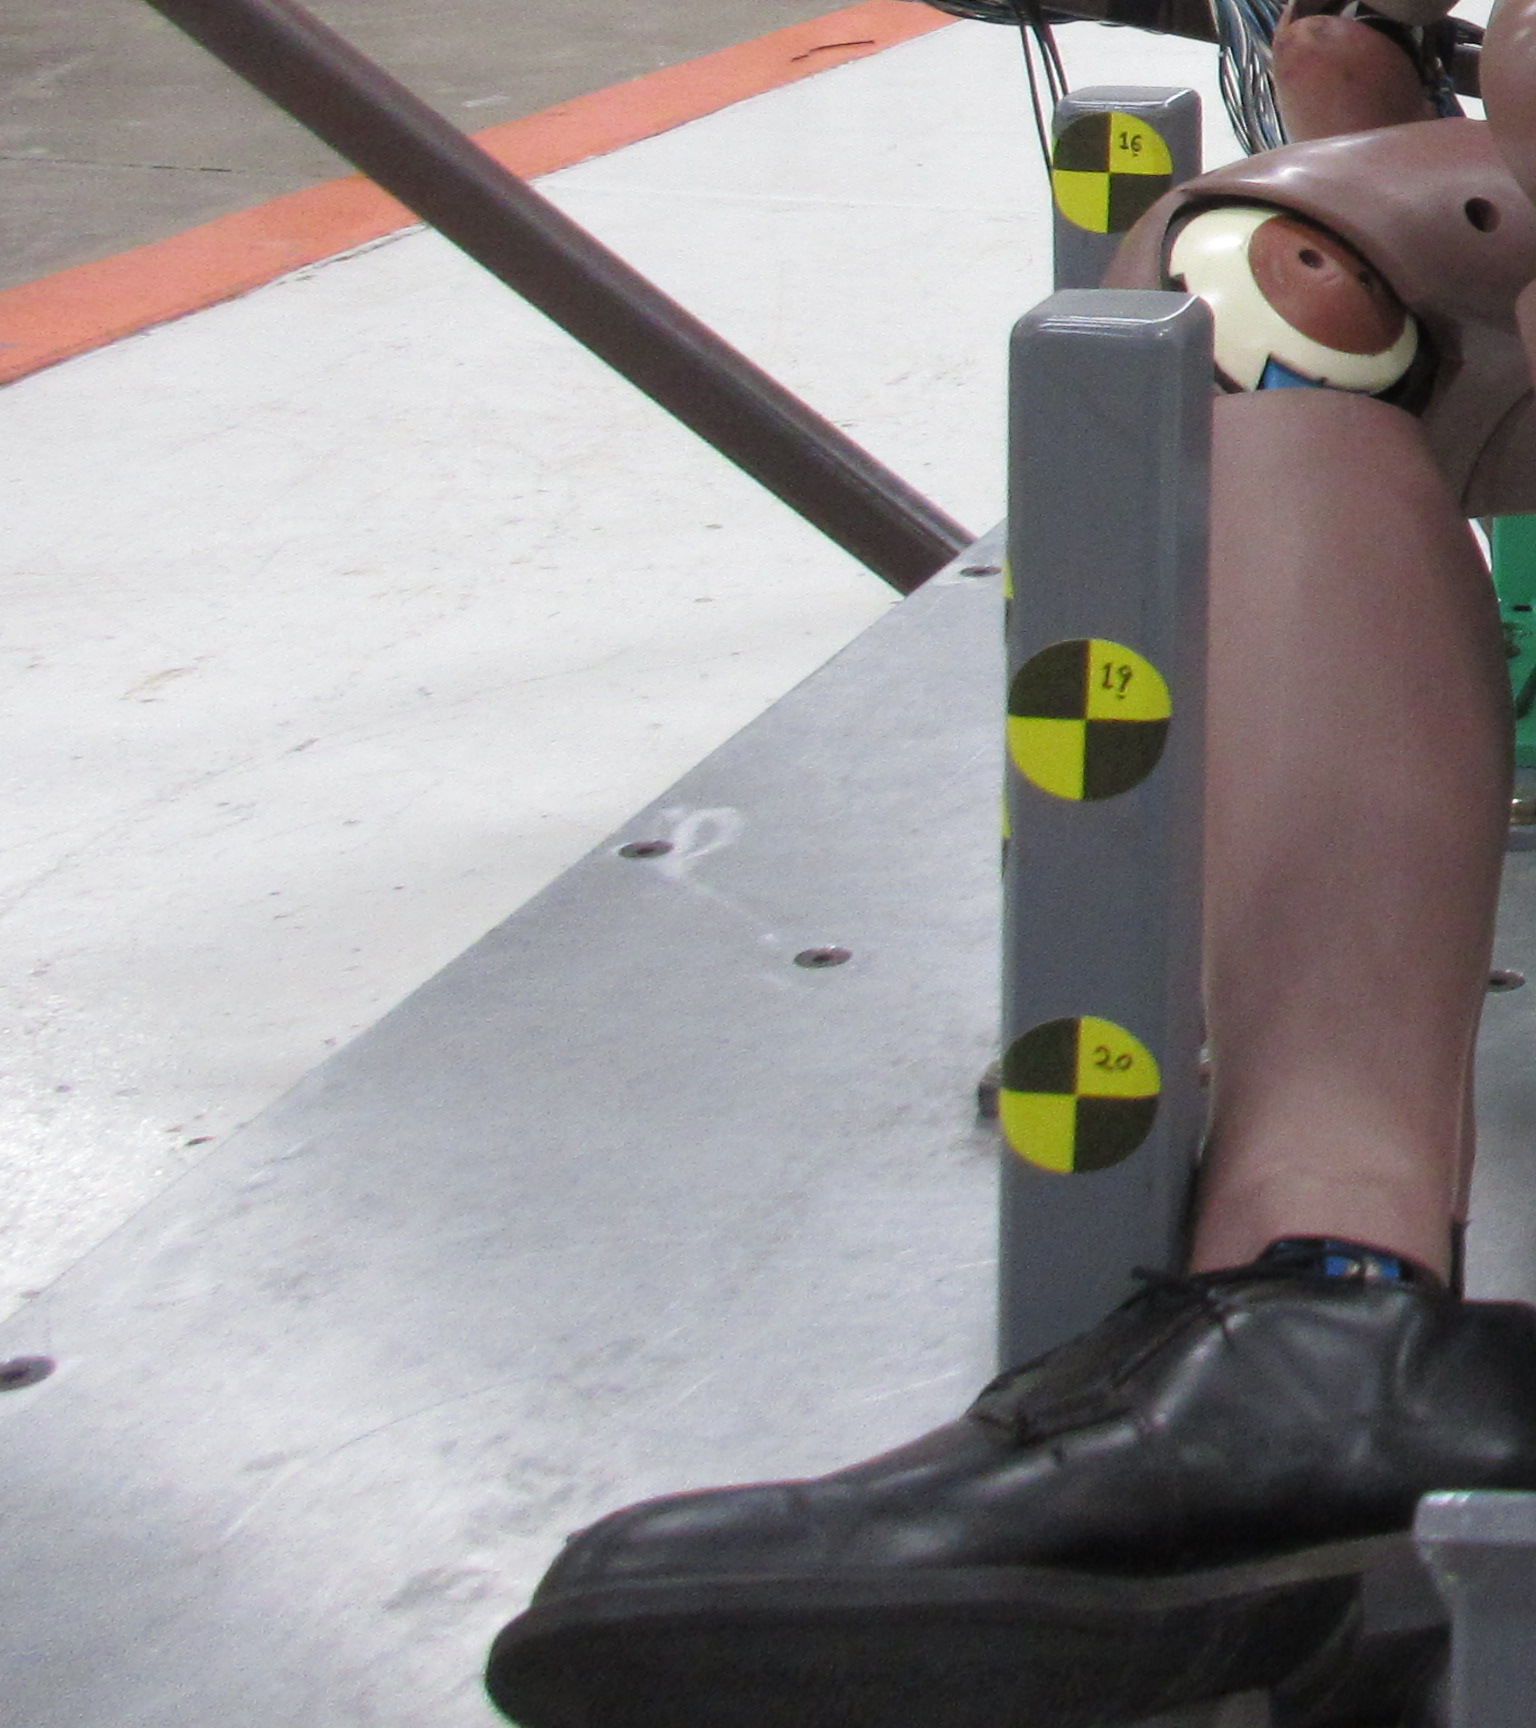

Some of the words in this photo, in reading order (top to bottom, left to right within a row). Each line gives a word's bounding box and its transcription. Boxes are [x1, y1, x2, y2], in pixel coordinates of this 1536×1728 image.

[1118, 131, 1143, 156] 16
[1102, 662, 1133, 699] 19
[1094, 1045, 1134, 1072] 20
